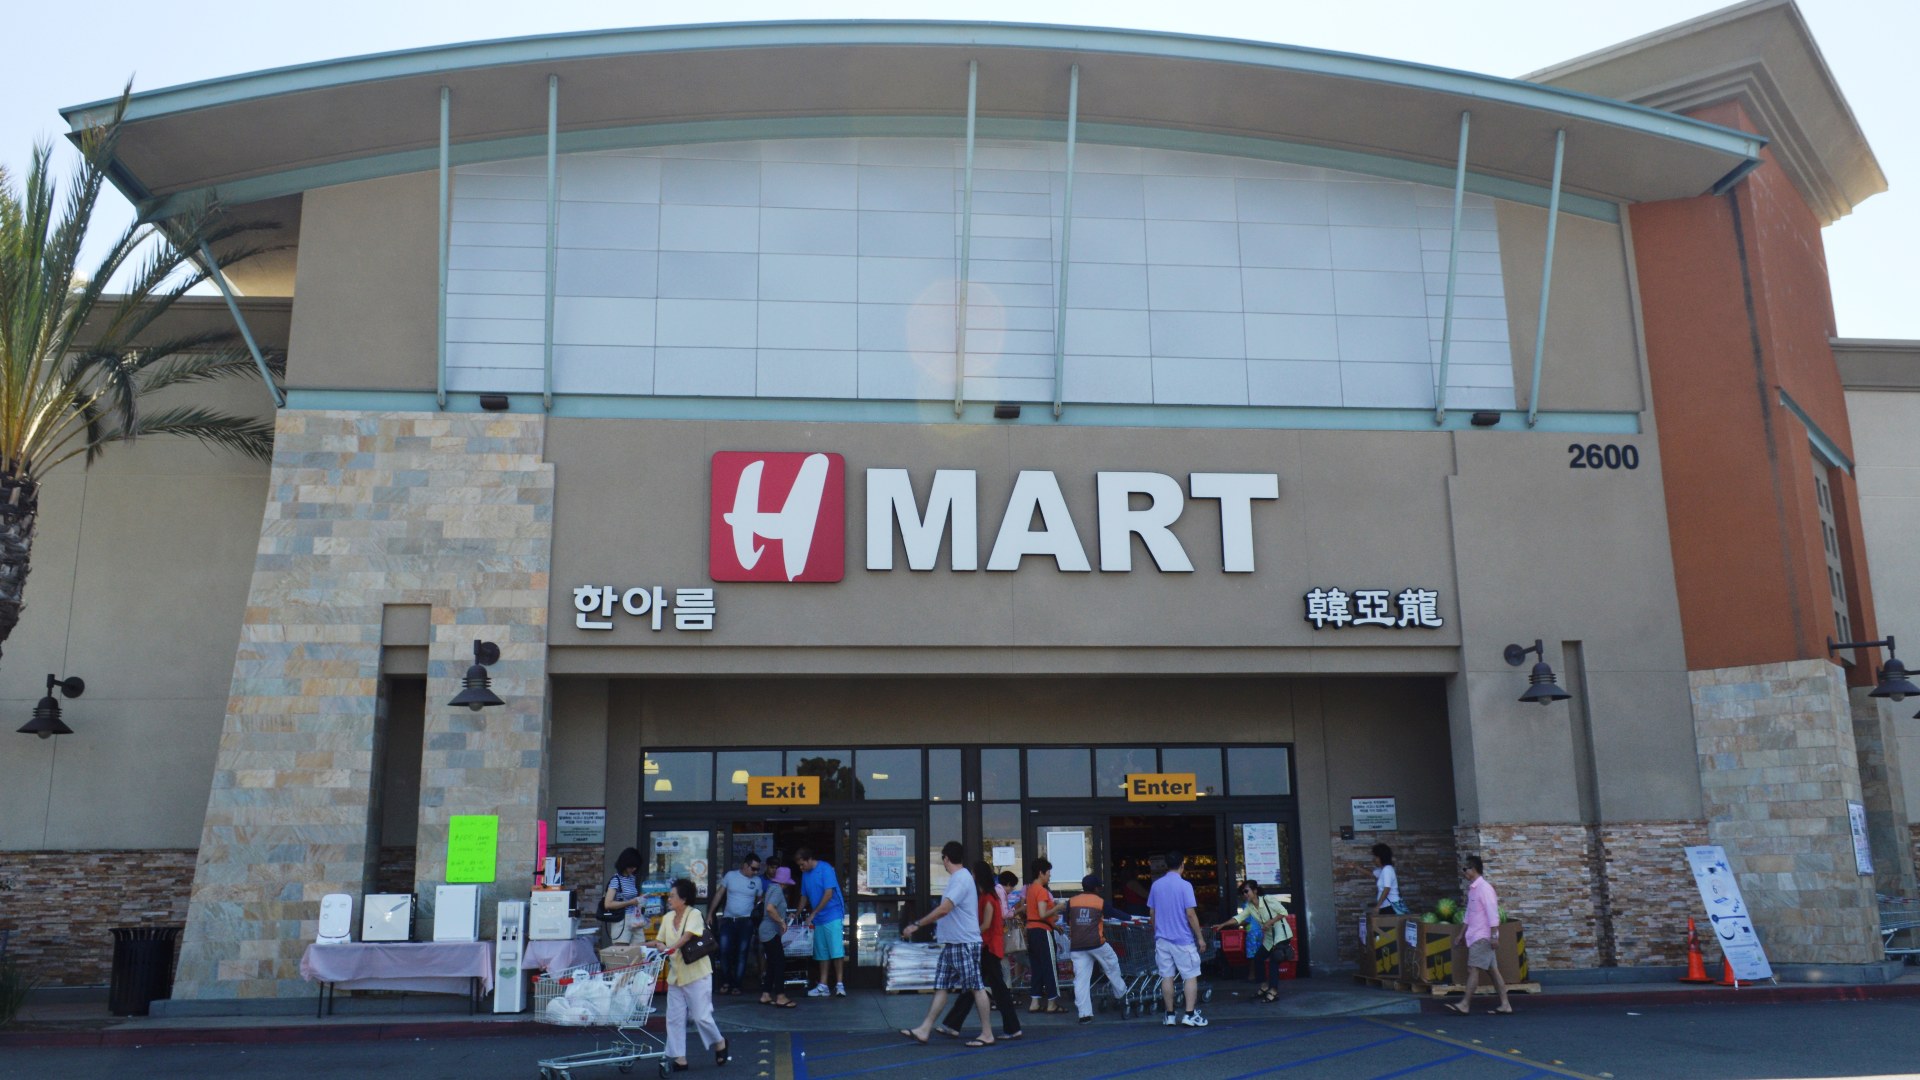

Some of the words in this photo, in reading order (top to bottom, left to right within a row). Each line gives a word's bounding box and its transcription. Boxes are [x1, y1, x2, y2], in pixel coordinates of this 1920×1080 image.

[1568, 443, 1640, 470] 2600
[722, 453, 830, 582] H
[865, 467, 1280, 574] MART
[573, 584, 717, 631] 한아름
[1304, 587, 1445, 630] 韓亞龍
[761, 782, 806, 799] Exit
[1133, 779, 1193, 795] Enter
